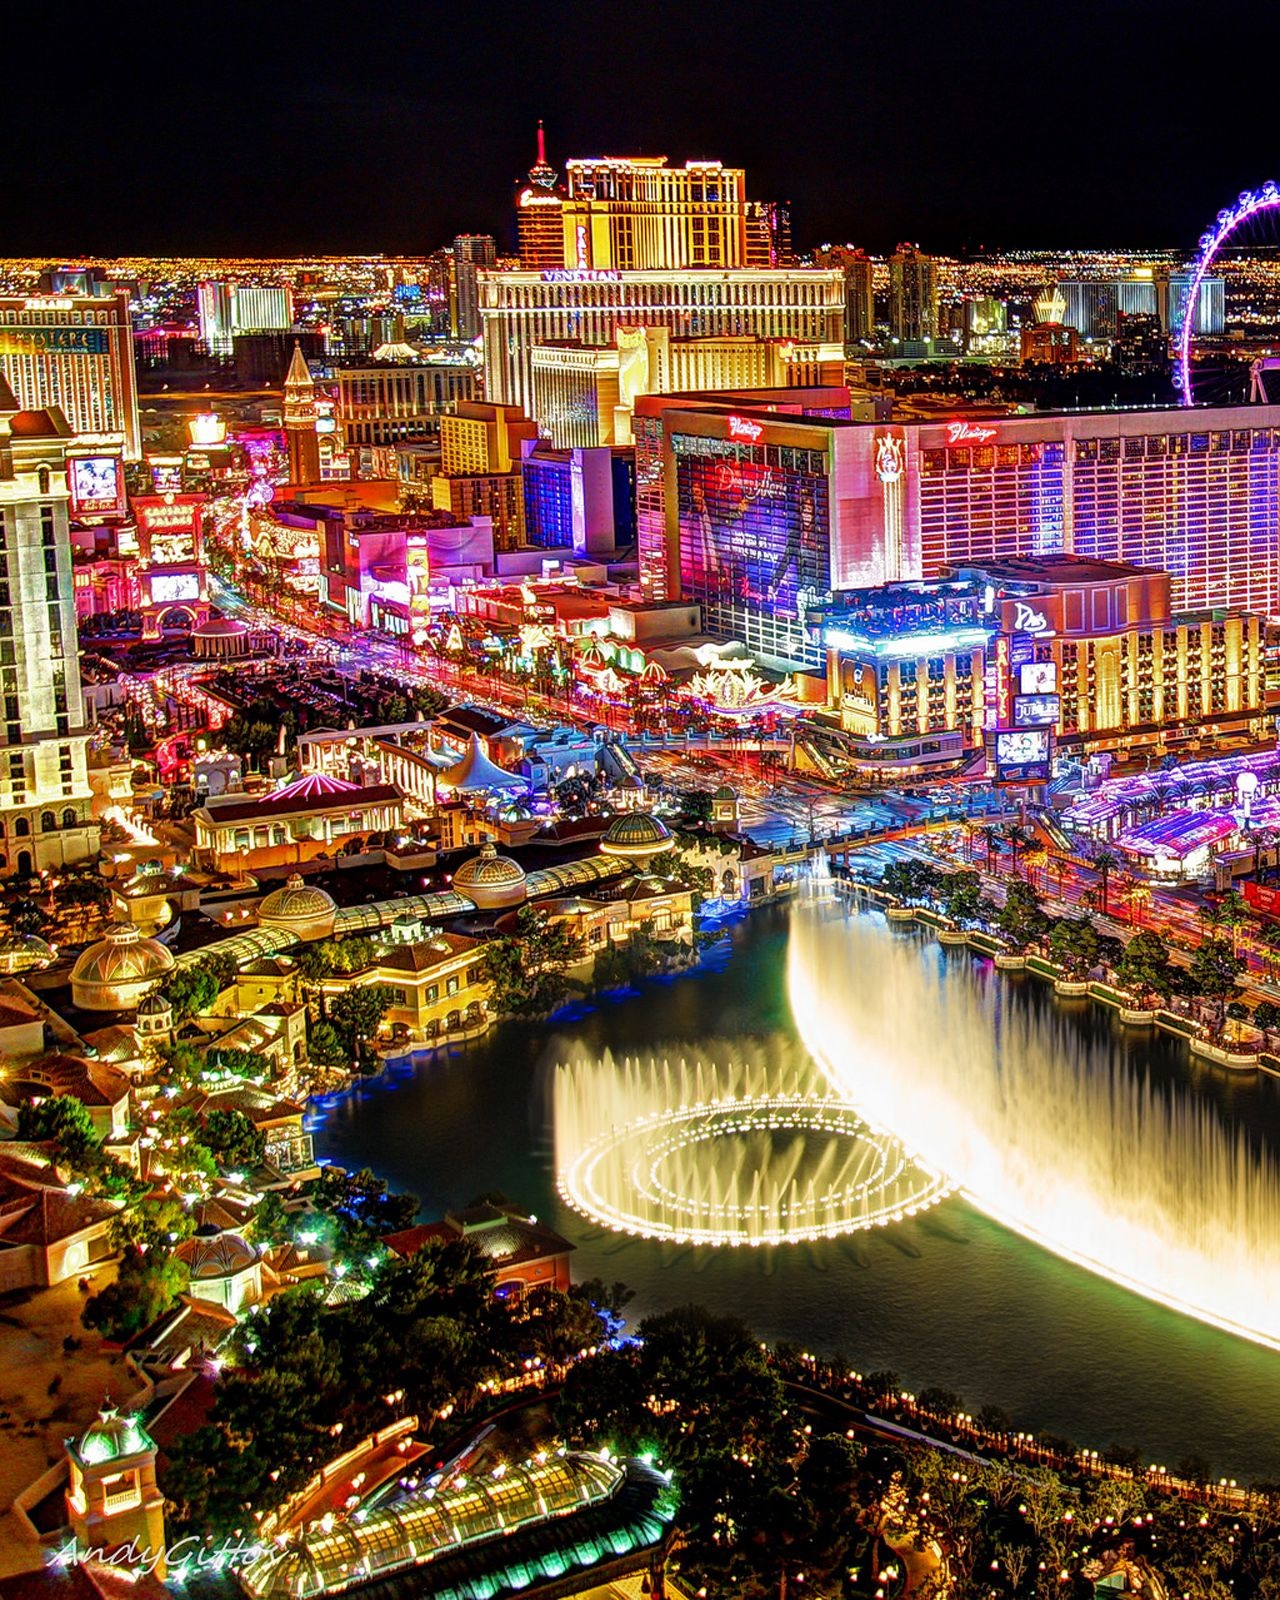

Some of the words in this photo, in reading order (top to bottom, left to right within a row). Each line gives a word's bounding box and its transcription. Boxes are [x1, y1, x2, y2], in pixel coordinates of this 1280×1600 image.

[543, 270, 618, 281] VENETIAN
[24, 300, 73, 310] ISLAND
[947, 421, 997, 443] Flamingo
[144, 506, 195, 518] CAESARS
[147, 516, 193, 528] PALACE
